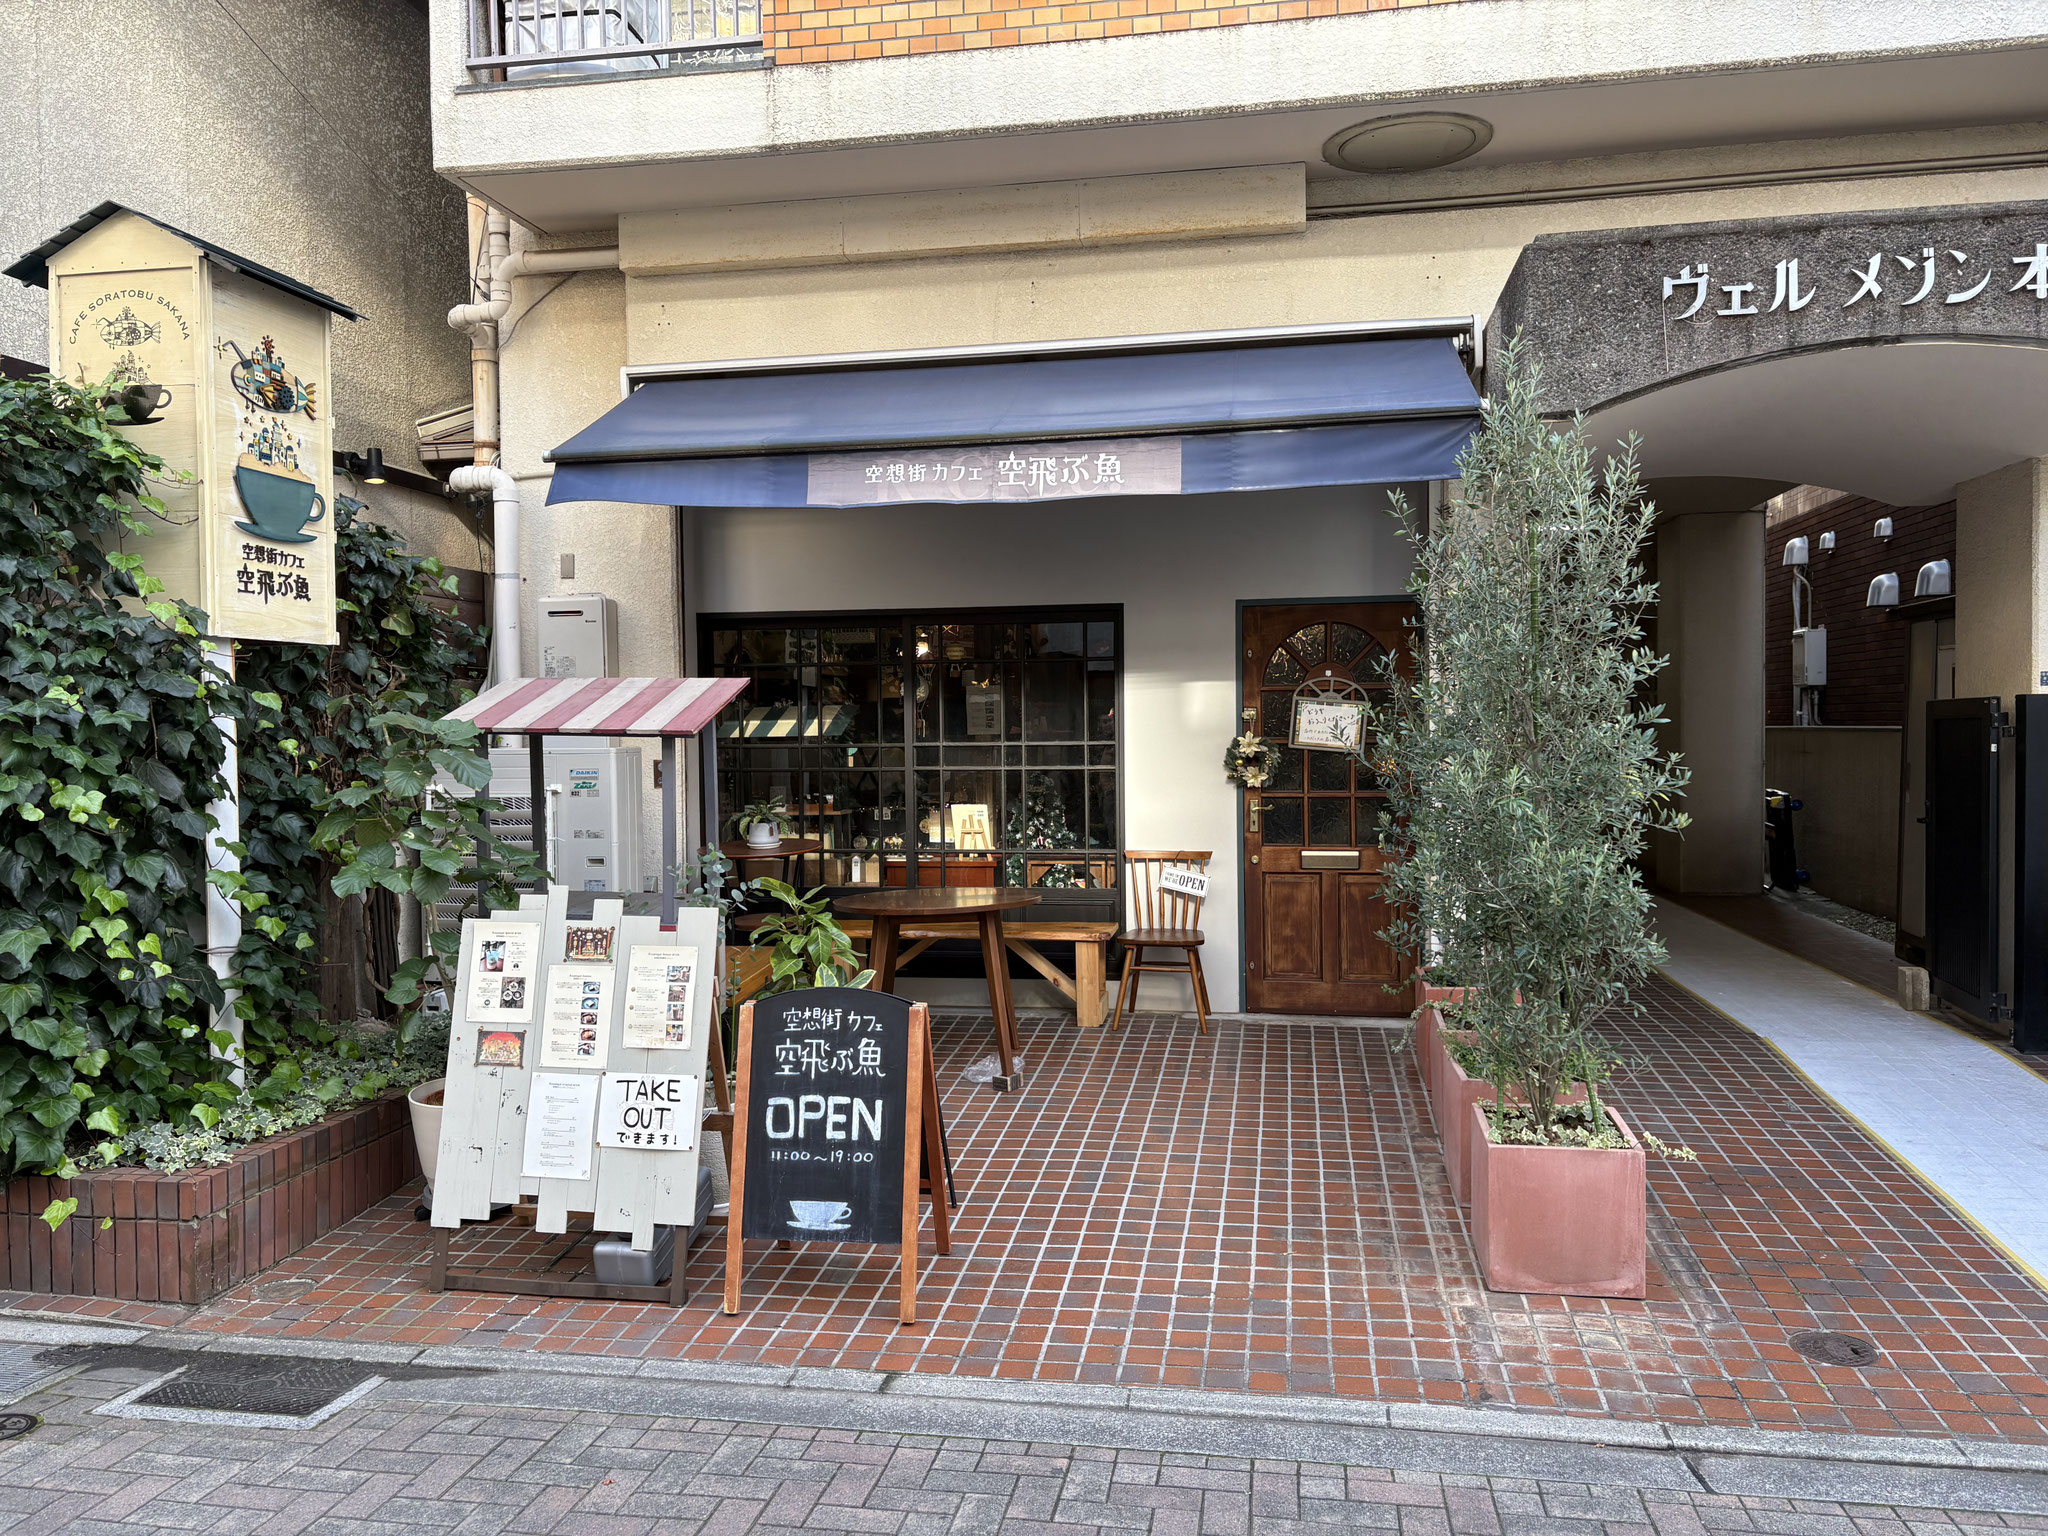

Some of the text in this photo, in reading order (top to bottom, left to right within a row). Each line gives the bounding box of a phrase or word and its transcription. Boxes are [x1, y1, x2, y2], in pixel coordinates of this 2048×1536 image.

[1663, 257, 1817, 320] ヴェル
[1842, 247, 1992, 309] メゾン
[69, 289, 191, 345] CAFE SORATOBU SAKANA
[997, 451, 1125, 497] 空飛ぶ魚
[236, 562, 312, 605] 空飛ぶ魚
[1178, 874, 1206, 892] OPEN
[774, 1037, 887, 1081] 空飛ぶ魚
[616, 1079, 681, 1103] TAKE
[623, 1106, 672, 1130] OUT
[765, 1094, 883, 1141] OPEN
